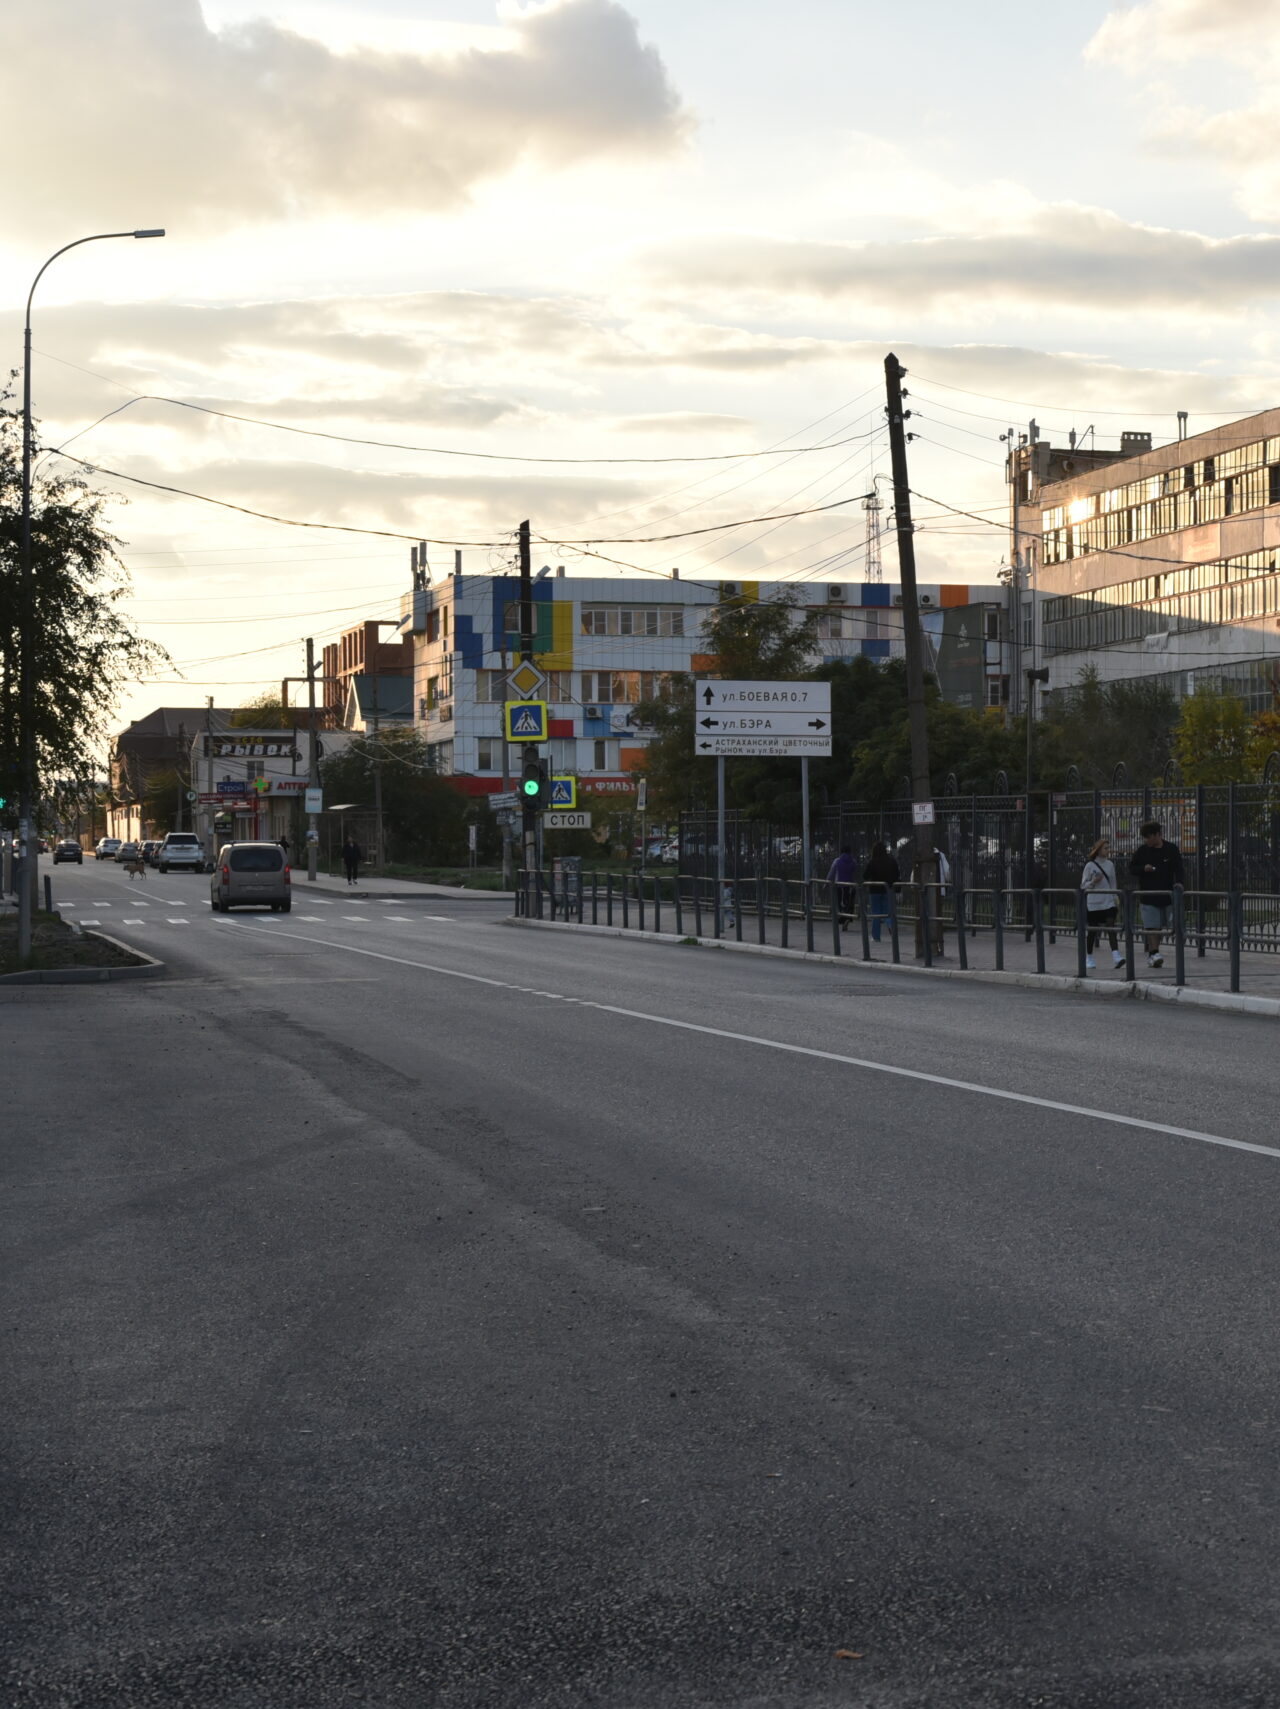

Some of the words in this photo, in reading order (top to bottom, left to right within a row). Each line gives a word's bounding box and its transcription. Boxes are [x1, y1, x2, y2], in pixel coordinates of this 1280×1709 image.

[722, 719, 772, 730] ул.БЭРА
[715, 738, 779, 746] АСТРАХАНСКИЙ
[783, 738, 830, 747] ЦВЕТОЧНЫЙ
[220, 744, 292, 756] РЫВОК
[715, 746, 744, 754] РЫНОК
[277, 781, 310, 791] АПТЕК
[551, 815, 585, 826] СТОП
